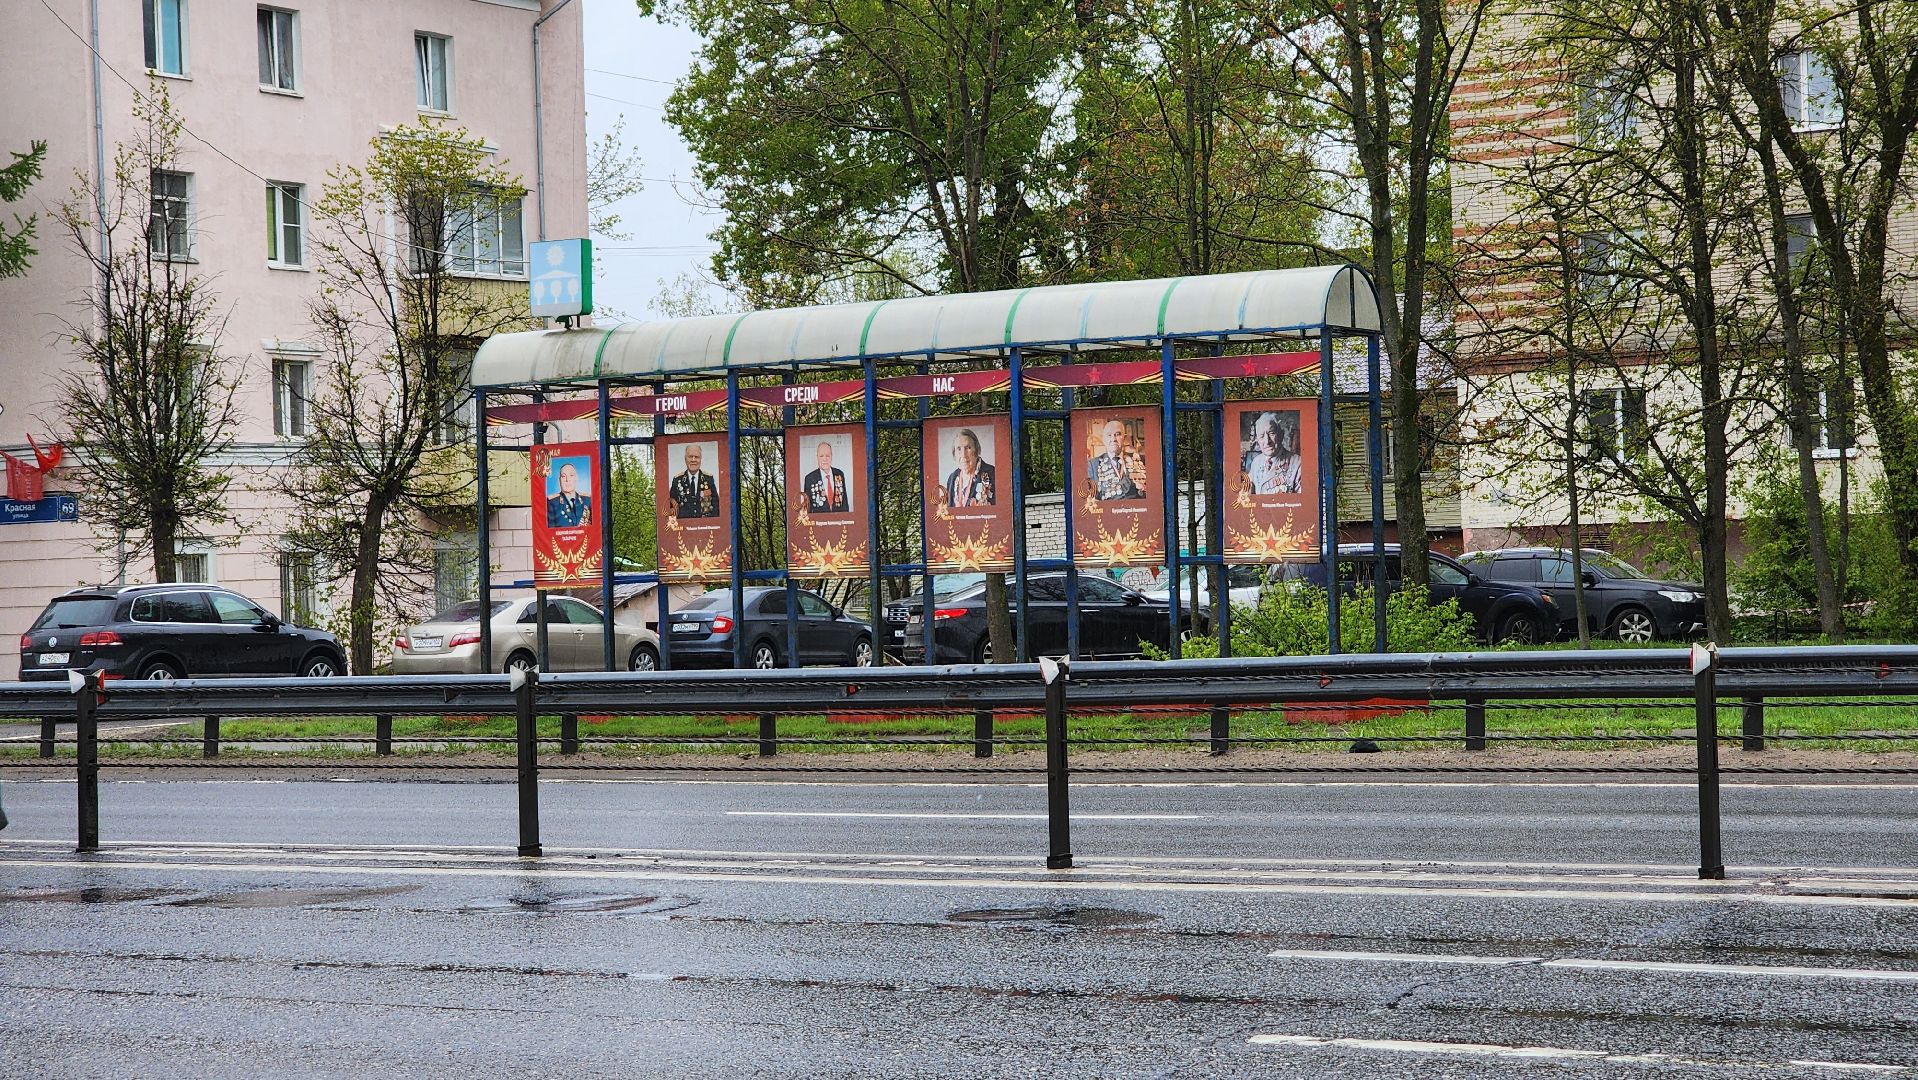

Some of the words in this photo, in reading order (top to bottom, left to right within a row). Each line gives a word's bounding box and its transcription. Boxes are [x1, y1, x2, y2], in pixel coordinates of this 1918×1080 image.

[655, 396, 687, 411] ГЕРОИ
[784, 386, 819, 403] СРЕДИ
[933, 376, 955, 392] НАС
[4, 503, 36, 513] Красная
[62, 502, 75, 513] 69
